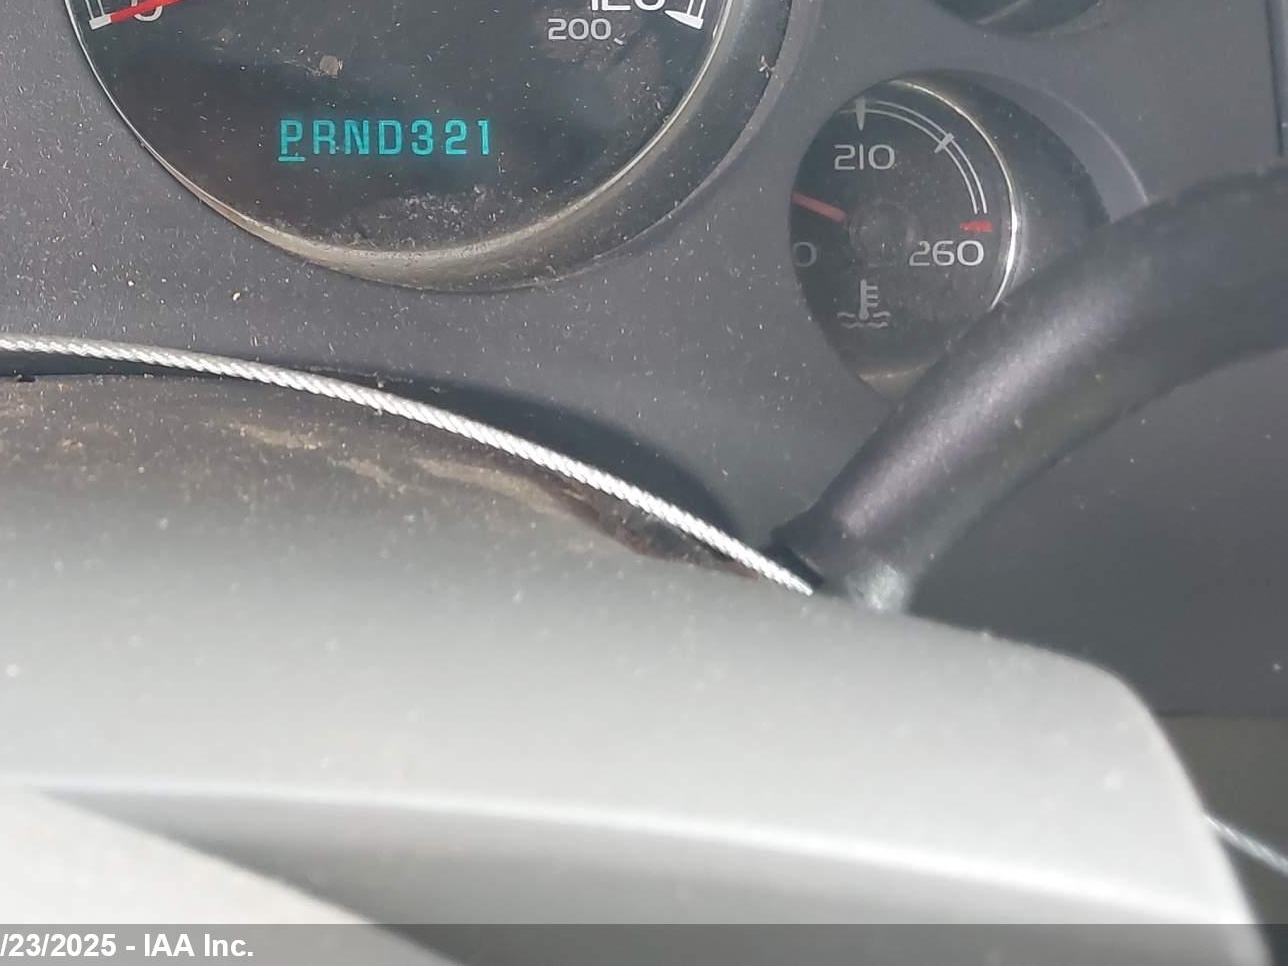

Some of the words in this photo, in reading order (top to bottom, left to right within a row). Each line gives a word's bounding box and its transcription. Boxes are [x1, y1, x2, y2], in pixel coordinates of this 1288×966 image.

[547, 18, 611, 41] 200
[279, 119, 490, 157] PRND321
[833, 144, 896, 171] 210
[909, 240, 985, 267] 260
